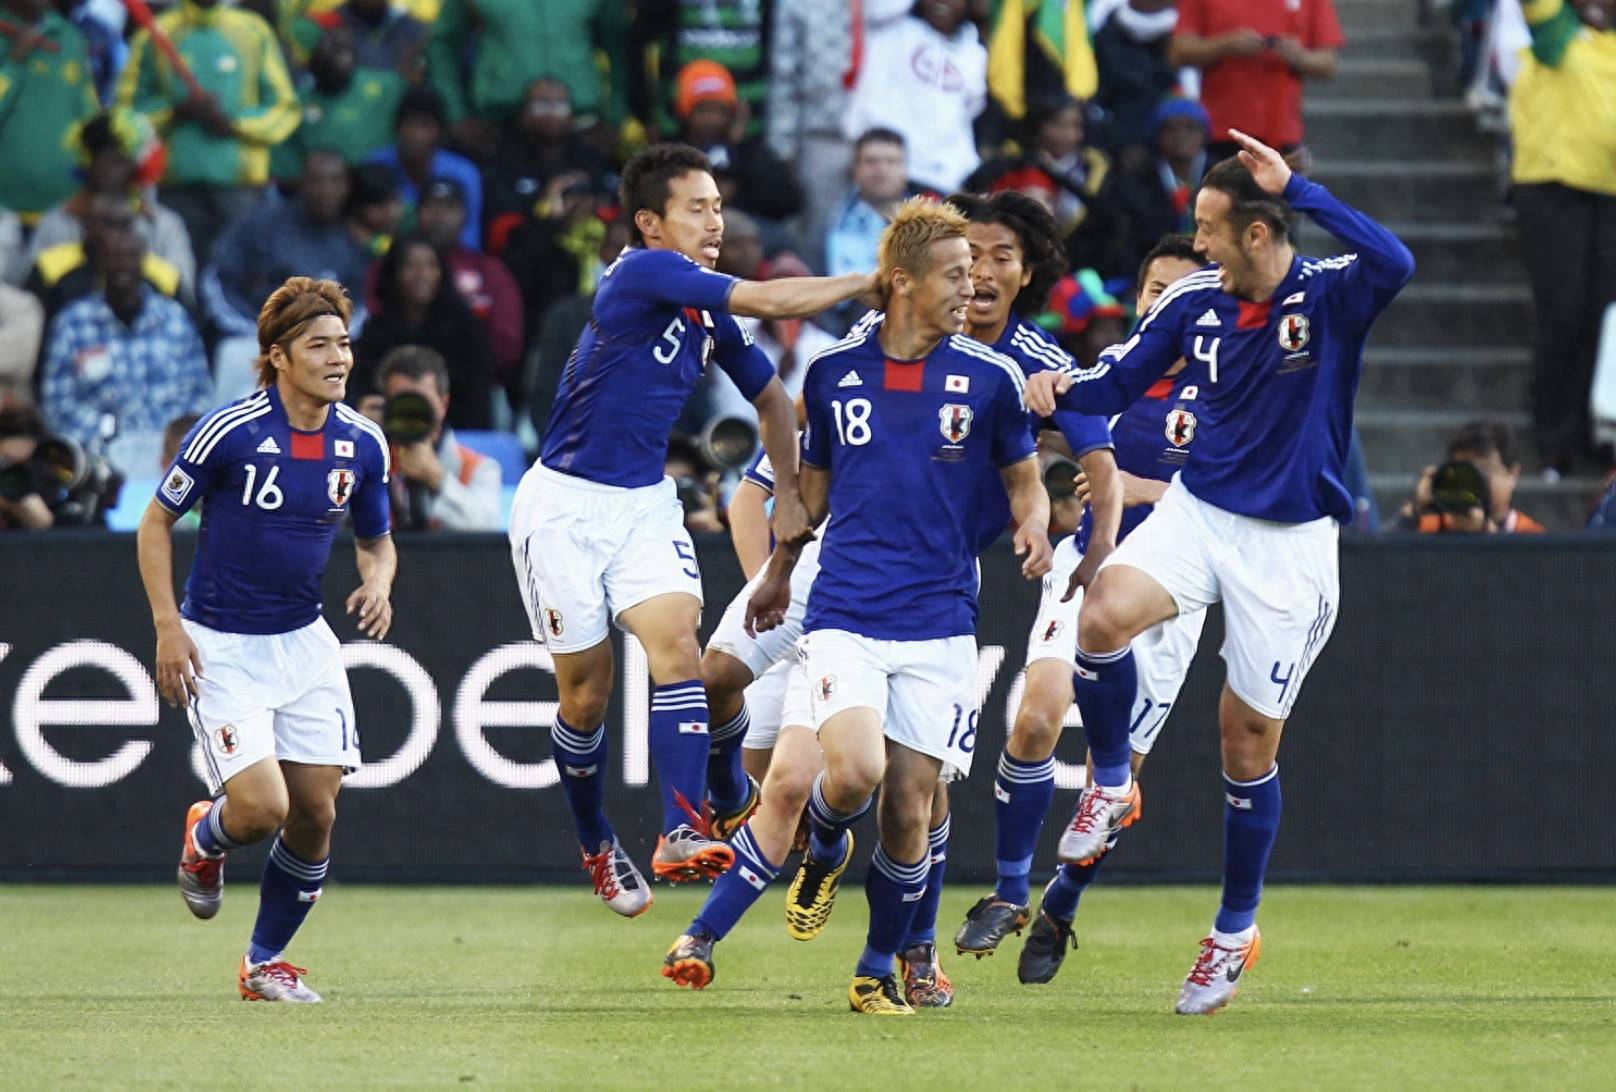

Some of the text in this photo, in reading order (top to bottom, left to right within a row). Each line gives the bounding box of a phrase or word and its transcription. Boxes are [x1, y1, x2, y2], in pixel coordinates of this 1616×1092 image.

[653, 316, 686, 365] 5
[1193, 335, 1221, 383] 4
[831, 397, 873, 446] 18
[242, 463, 284, 510] 16
[671, 540, 699, 580] 5
[1270, 660, 1295, 704] 4
[335, 707, 361, 751] 1
[1128, 697, 1172, 738] 17
